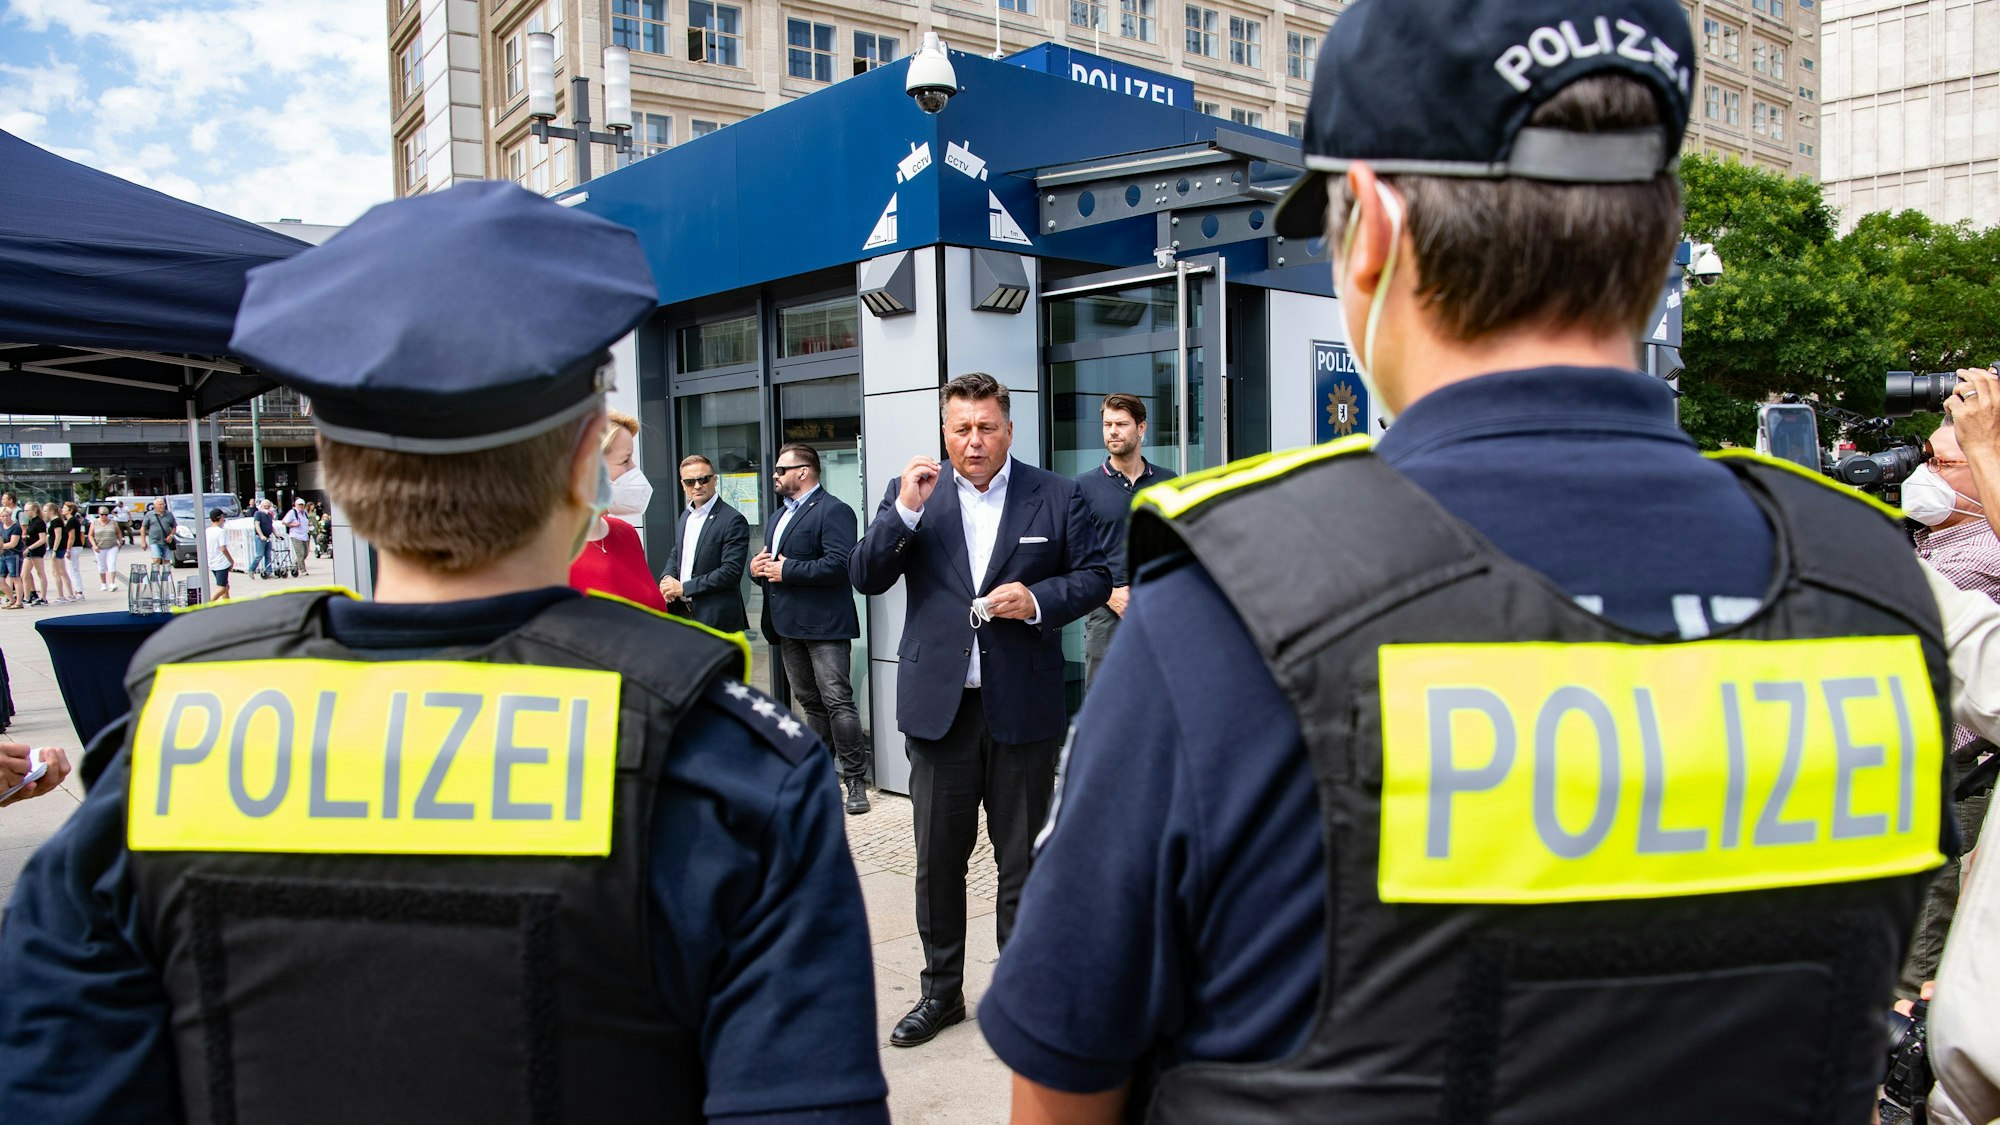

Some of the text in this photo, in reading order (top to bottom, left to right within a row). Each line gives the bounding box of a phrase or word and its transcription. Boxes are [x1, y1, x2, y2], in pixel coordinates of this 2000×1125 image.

[912, 154, 930, 174] CCTV
[946, 154, 970, 172] CCTV
[1317, 350, 1362, 374] POLIZ
[154, 688, 589, 821] POLIZEI
[1425, 675, 1915, 860] POLIZEI
